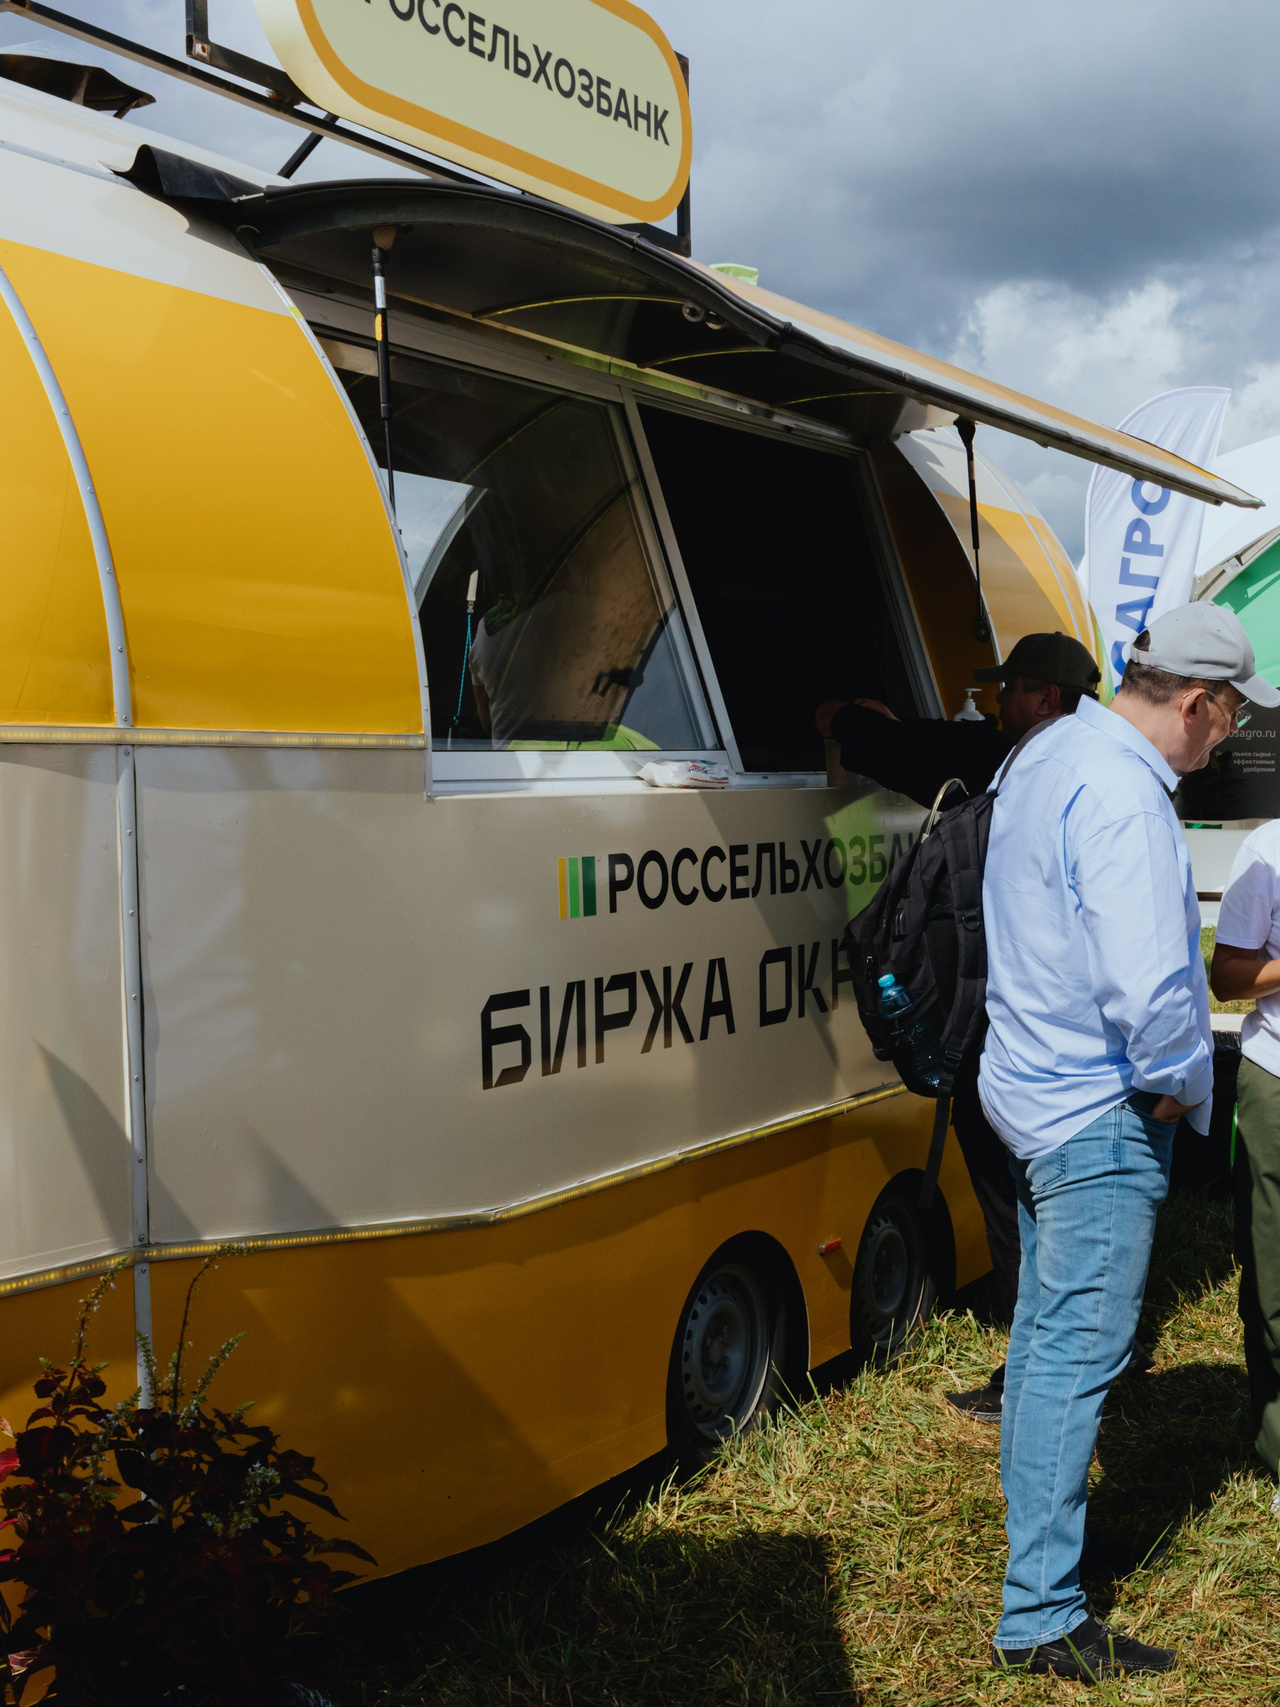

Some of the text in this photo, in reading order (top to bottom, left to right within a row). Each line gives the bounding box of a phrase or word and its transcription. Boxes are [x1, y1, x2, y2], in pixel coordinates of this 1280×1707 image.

[364, 0, 670, 147] ОССЕЛЬХОЗБАНК
[1227, 730, 1276, 740] osagro.ru
[608, 832, 914, 914] РОССЕЛЬХОЗБА
[480, 956, 737, 1090] БИРЖА
